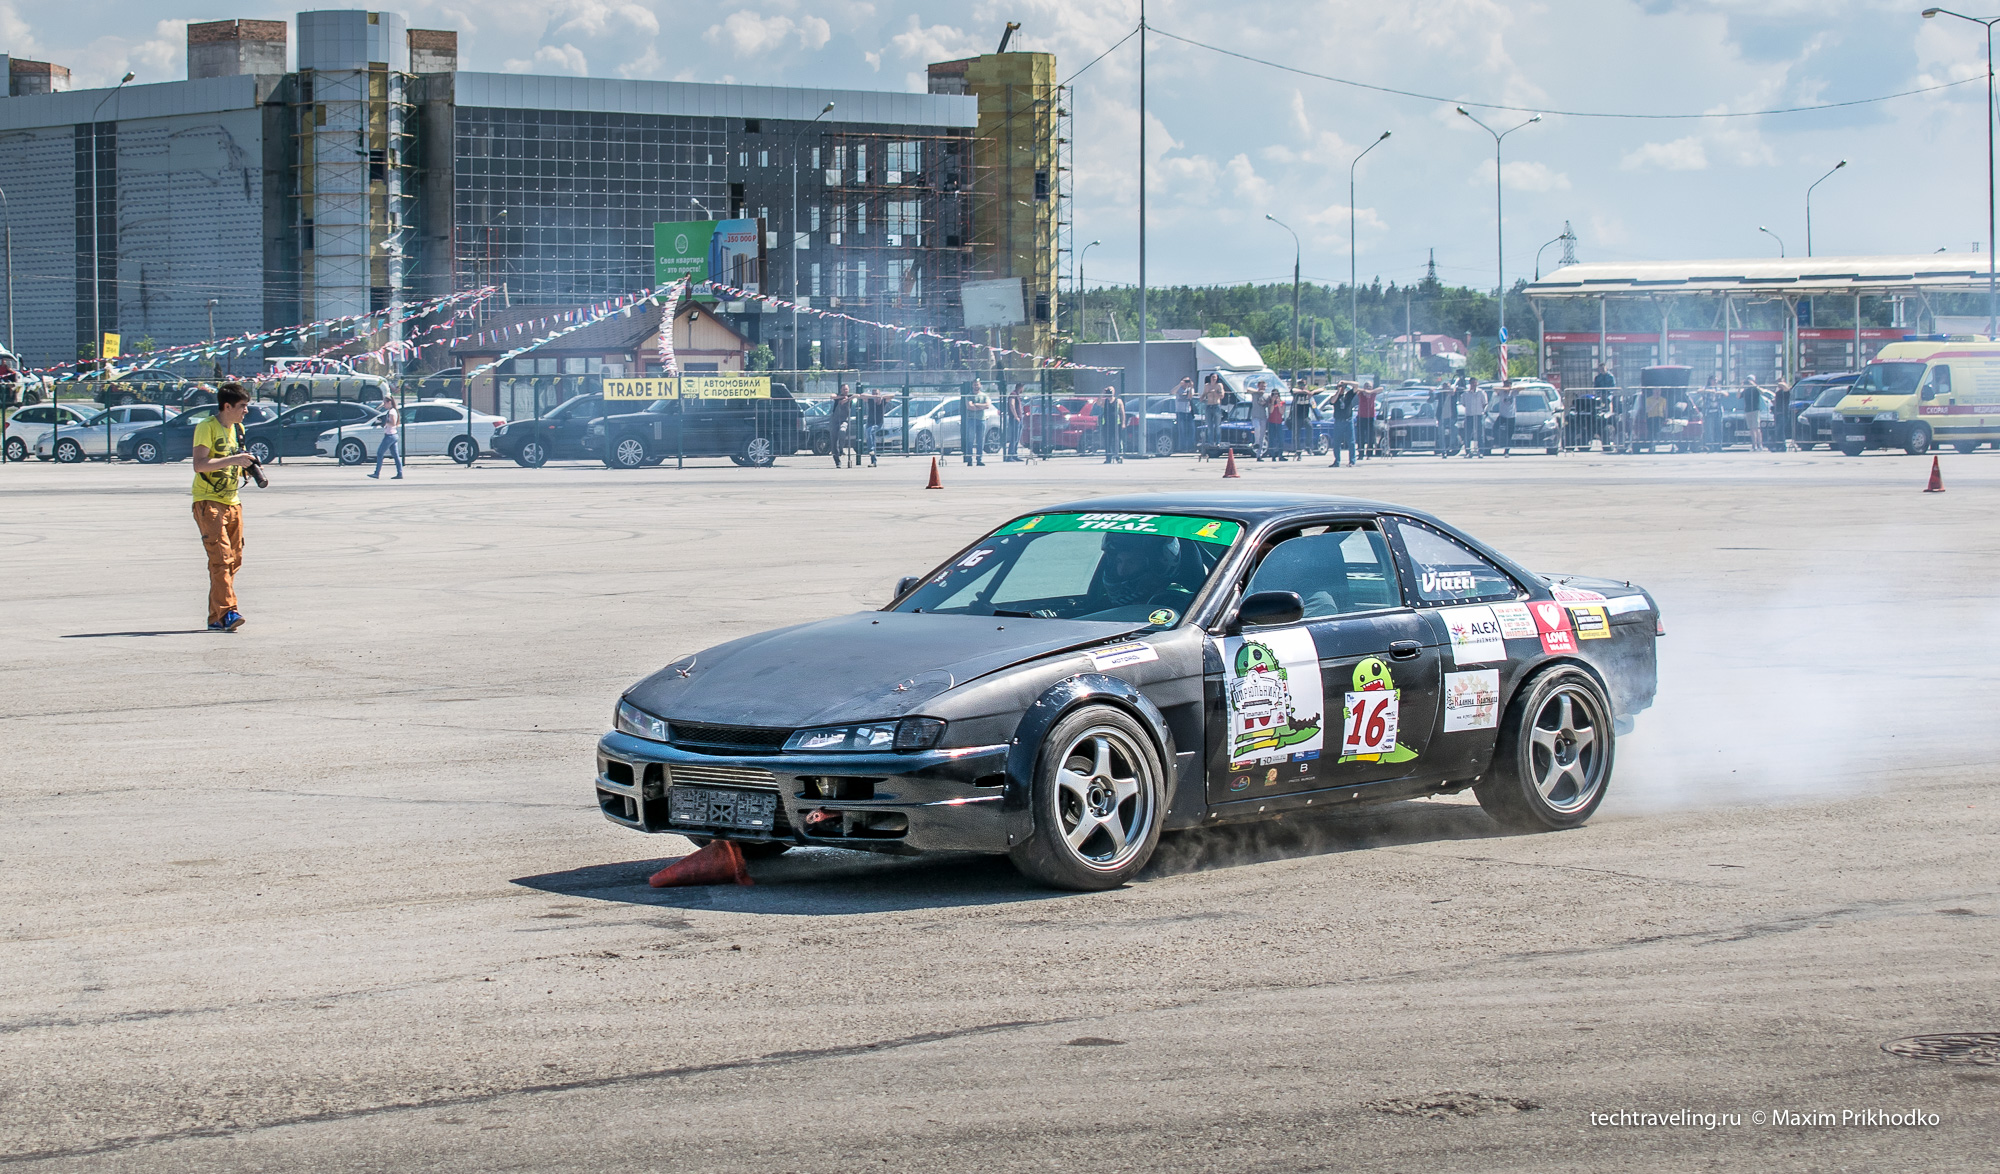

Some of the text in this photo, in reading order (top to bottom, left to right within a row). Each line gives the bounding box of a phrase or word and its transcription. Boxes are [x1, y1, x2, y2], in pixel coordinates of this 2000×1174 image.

[660, 256, 705, 265] Своя квартира
[678, 265, 701, 274] просто!
[608, 381, 673, 398] TRADE IN
[703, 379, 761, 388] АВТОМОБИЛИ
[703, 388, 757, 397] С ПРОБЕГОМ
[1926, 406, 1949, 414] СКОРАЯ
[1076, 513, 1162, 523] DRIFT
[1077, 520, 1149, 532] THAT
[957, 549, 994, 567] 16
[1421, 572, 1476, 593] Viatti
[1471, 621, 1499, 635] ALEX
[1545, 631, 1569, 644] LOVE
[1233, 685, 1278, 703] ЦИРЮЛЬНИК
[1346, 697, 1389, 748] 16
